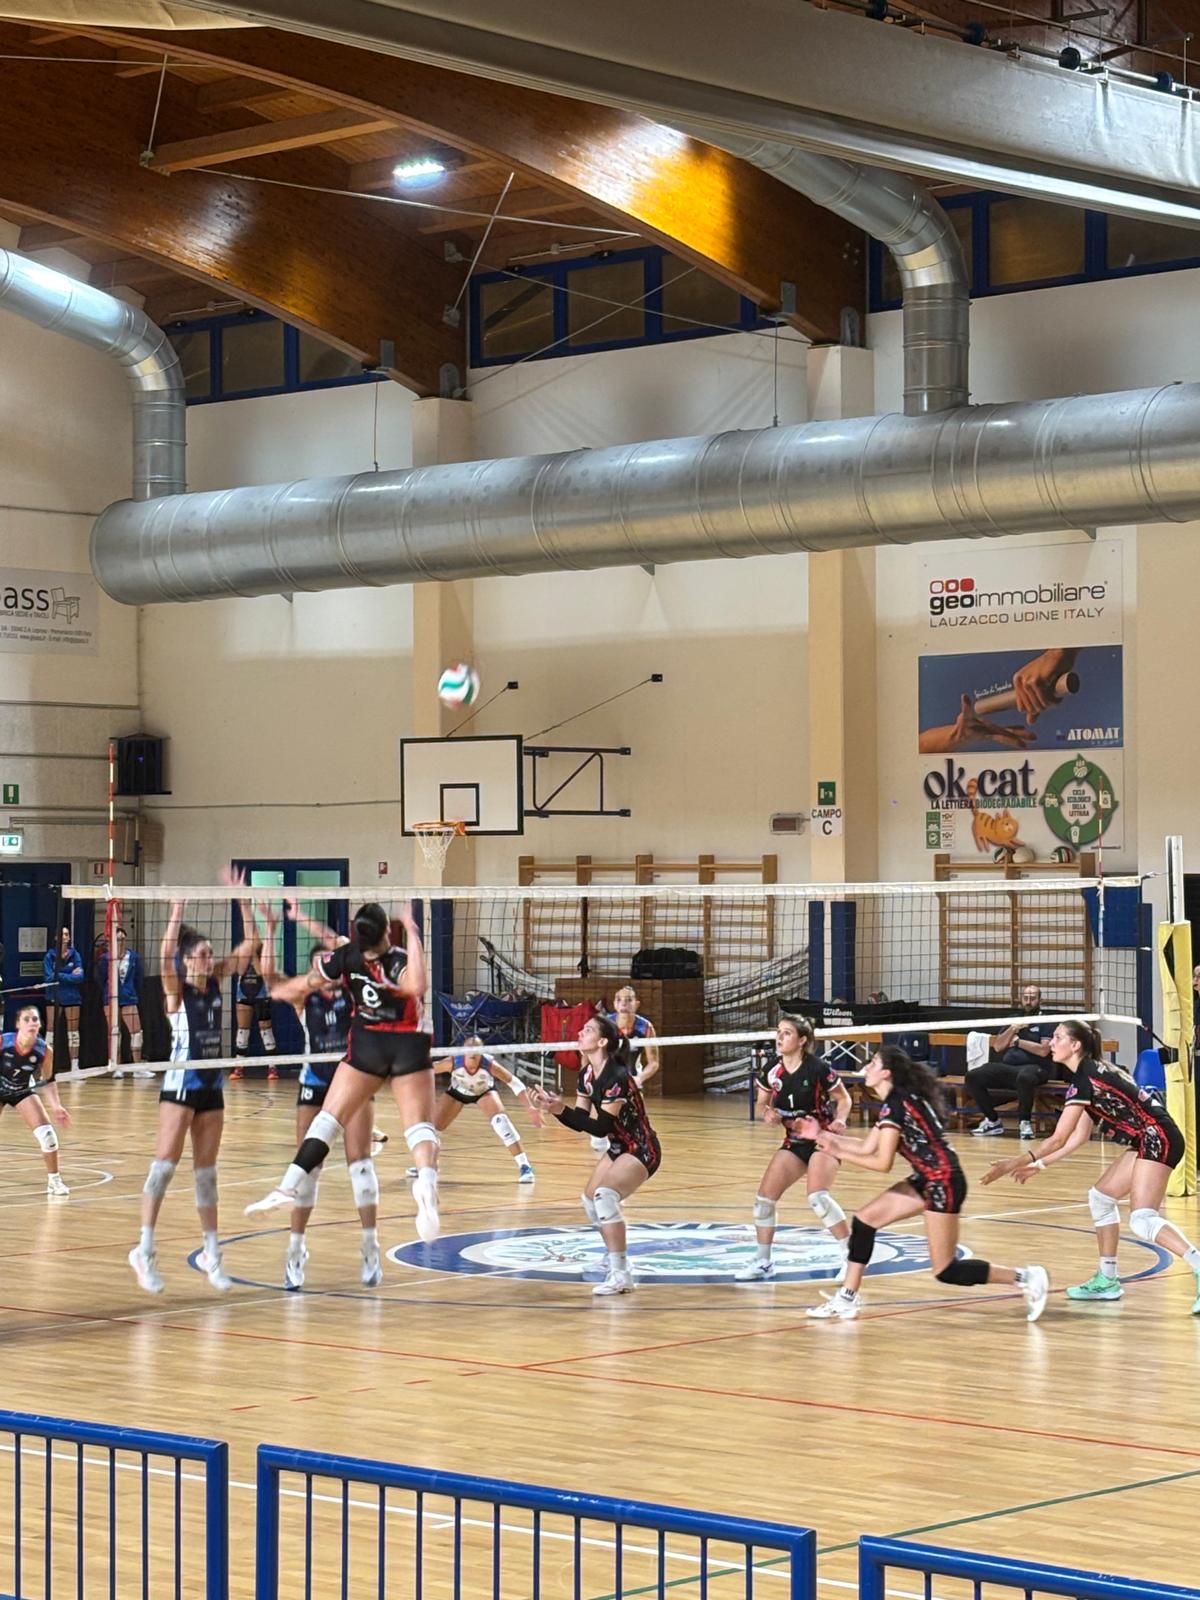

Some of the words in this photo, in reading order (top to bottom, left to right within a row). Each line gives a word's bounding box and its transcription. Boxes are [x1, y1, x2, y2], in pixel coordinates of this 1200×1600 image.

[930, 583, 1104, 615] geoimmobiliare
[930, 613, 1009, 628] LAUZACCO
[1013, 609, 1059, 623] UDINE
[1063, 607, 1104, 619] ITALY
[1067, 727, 1120, 741] ATOMAT
[924, 758, 968, 800] ok
[977, 759, 1038, 798] cat
[931, 799, 940, 810] LA
[942, 798, 974, 810] LETTIERA
[811, 808, 842, 819] CAMPO
[822, 820, 833, 835] C
[787, 1093, 795, 1109] 1
